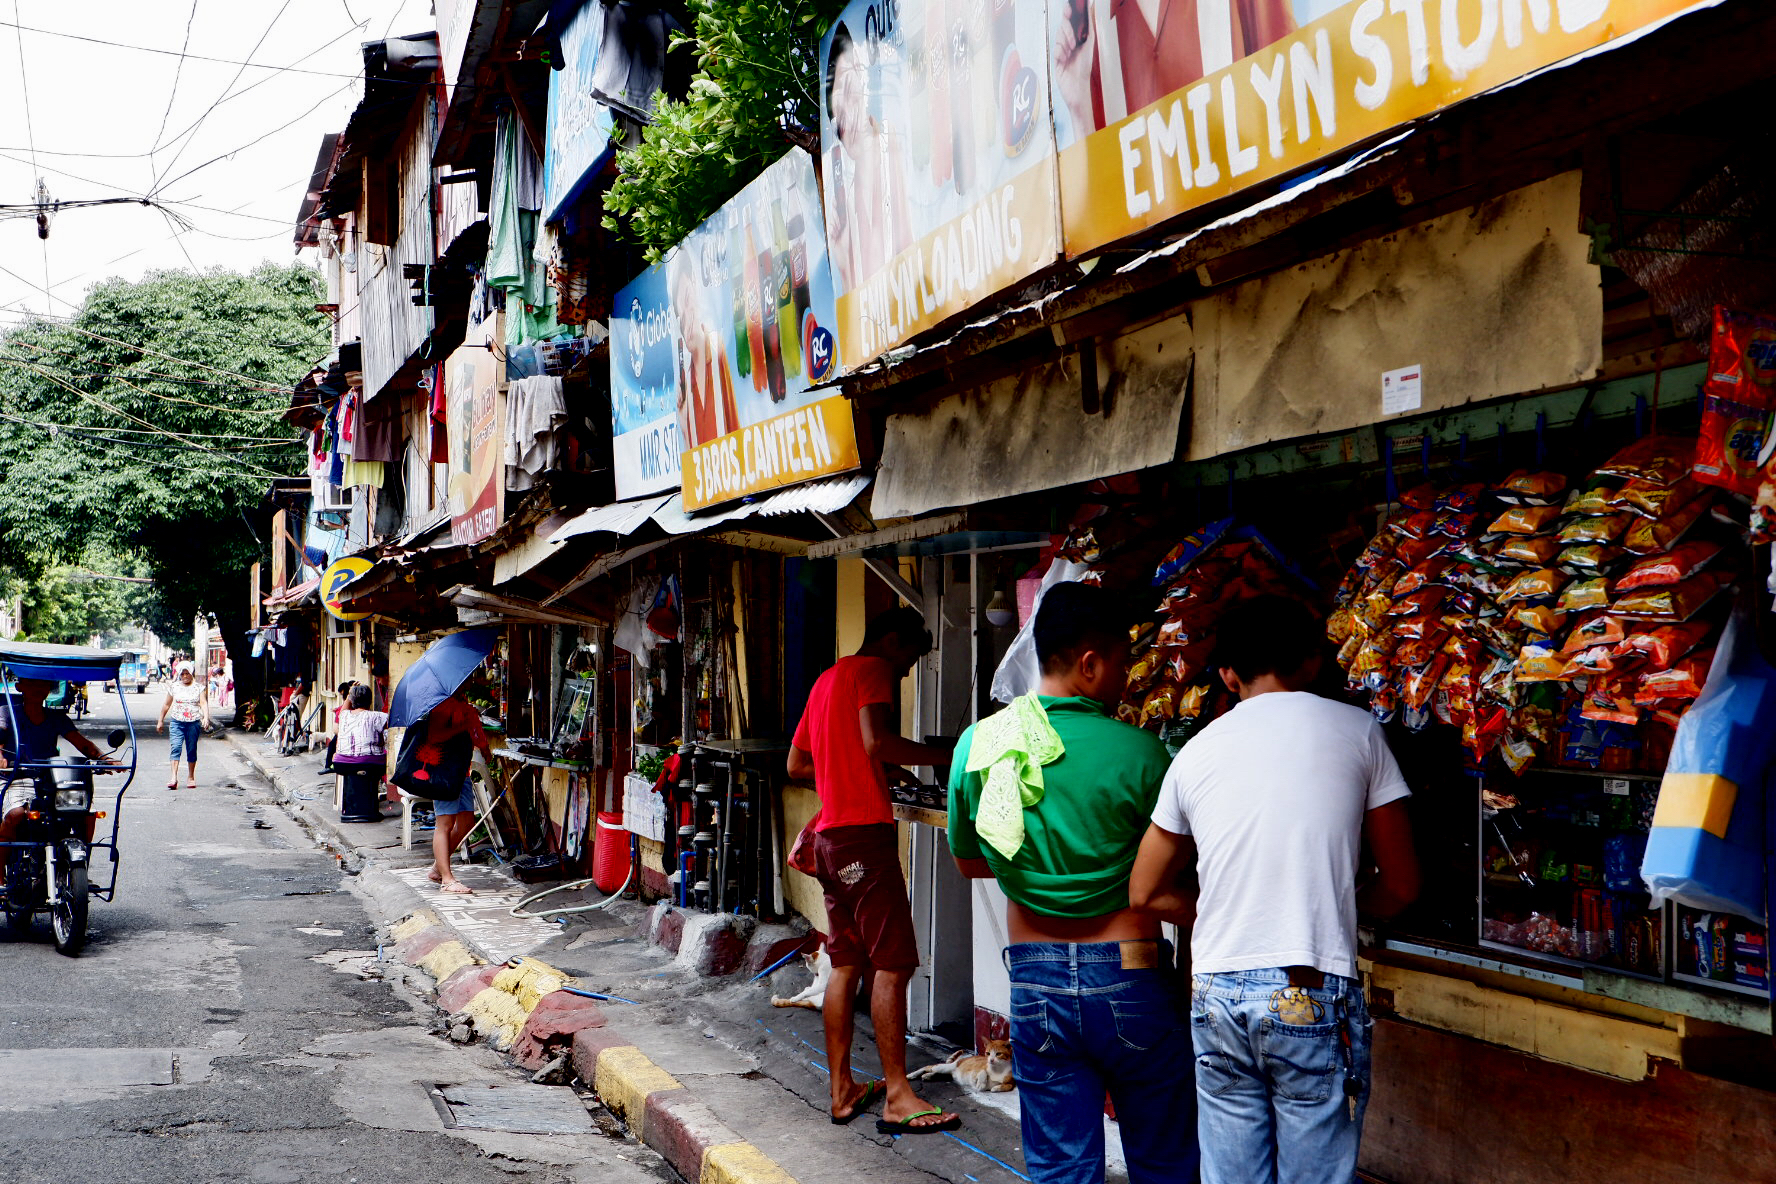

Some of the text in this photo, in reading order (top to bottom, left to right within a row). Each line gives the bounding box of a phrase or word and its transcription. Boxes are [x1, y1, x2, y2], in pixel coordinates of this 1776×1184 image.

[1118, 30, 1336, 219] EMILYN
[859, 255, 919, 358] EMILYN
[917, 184, 1022, 315] LOADING
[812, 333, 828, 365] RC
[475, 505, 496, 537] EATERY
